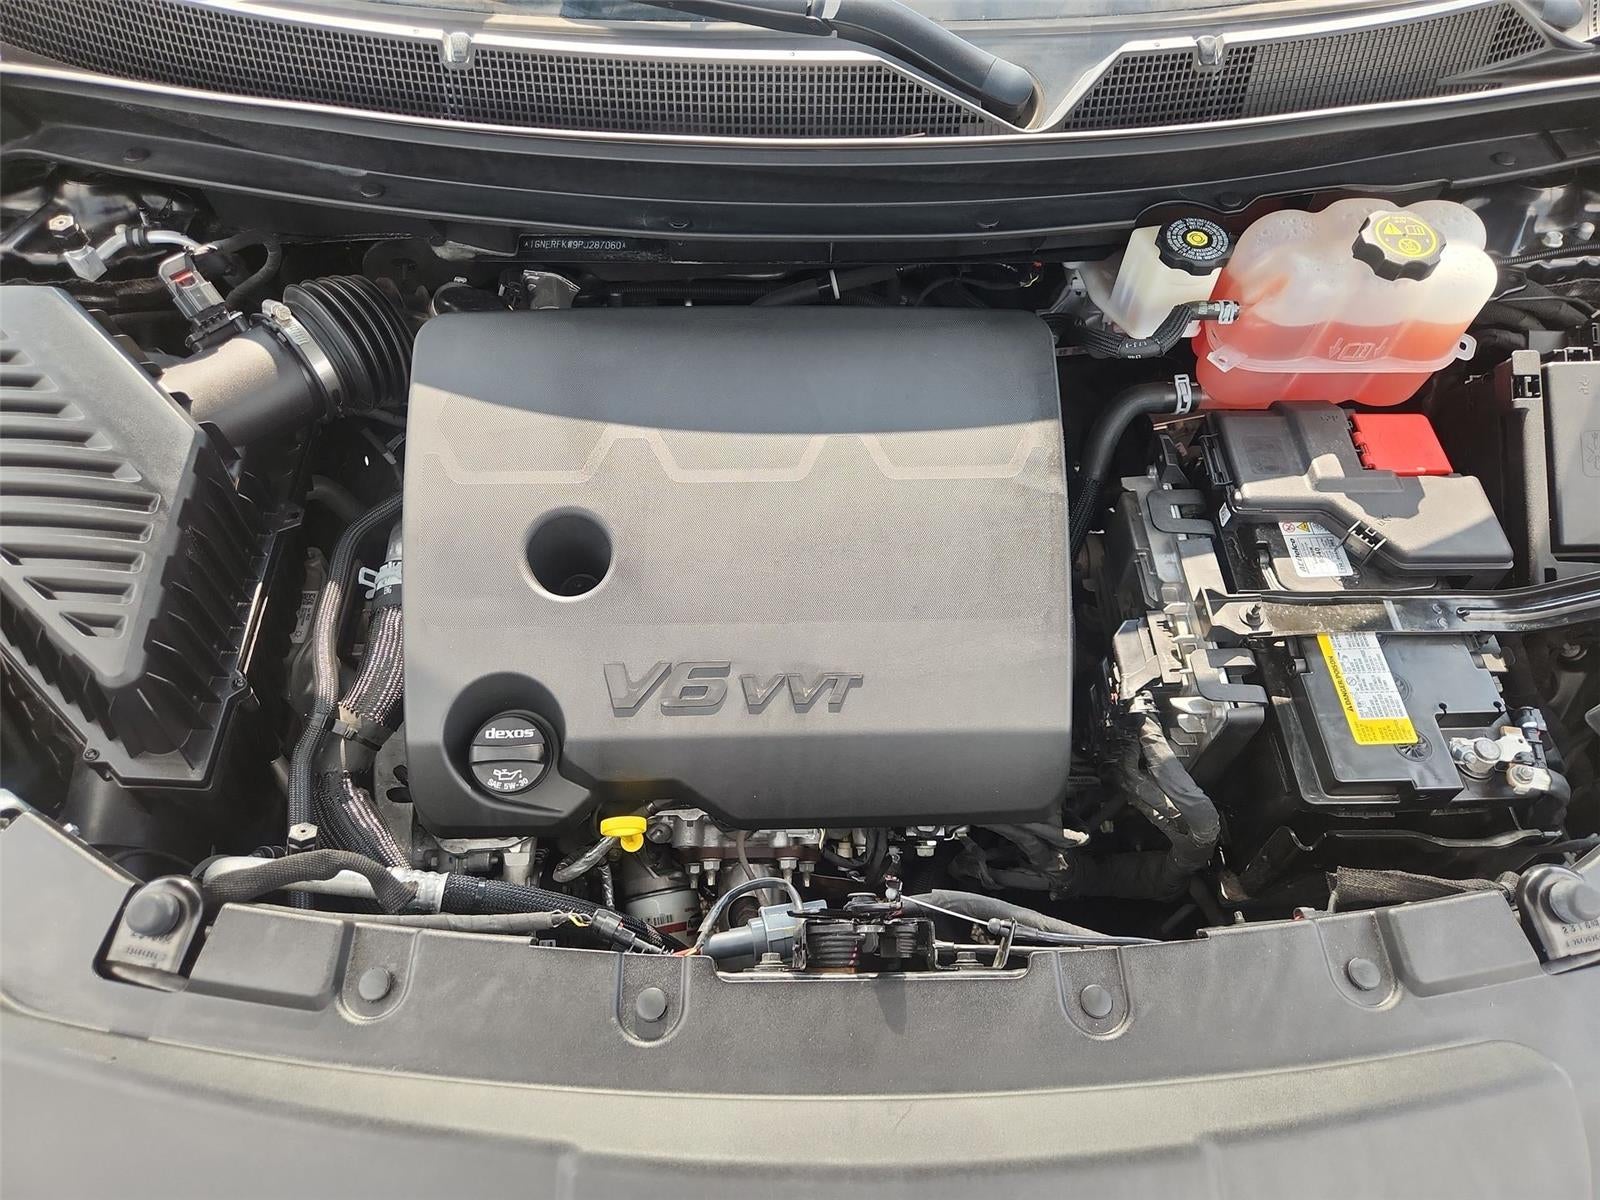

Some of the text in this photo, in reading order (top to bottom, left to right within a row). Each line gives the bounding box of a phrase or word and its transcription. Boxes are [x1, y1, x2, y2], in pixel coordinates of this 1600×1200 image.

[603, 660, 864, 718] V6 VVT
[484, 727, 536, 739] dexos
[487, 777, 529, 790] SAE 5W-30
